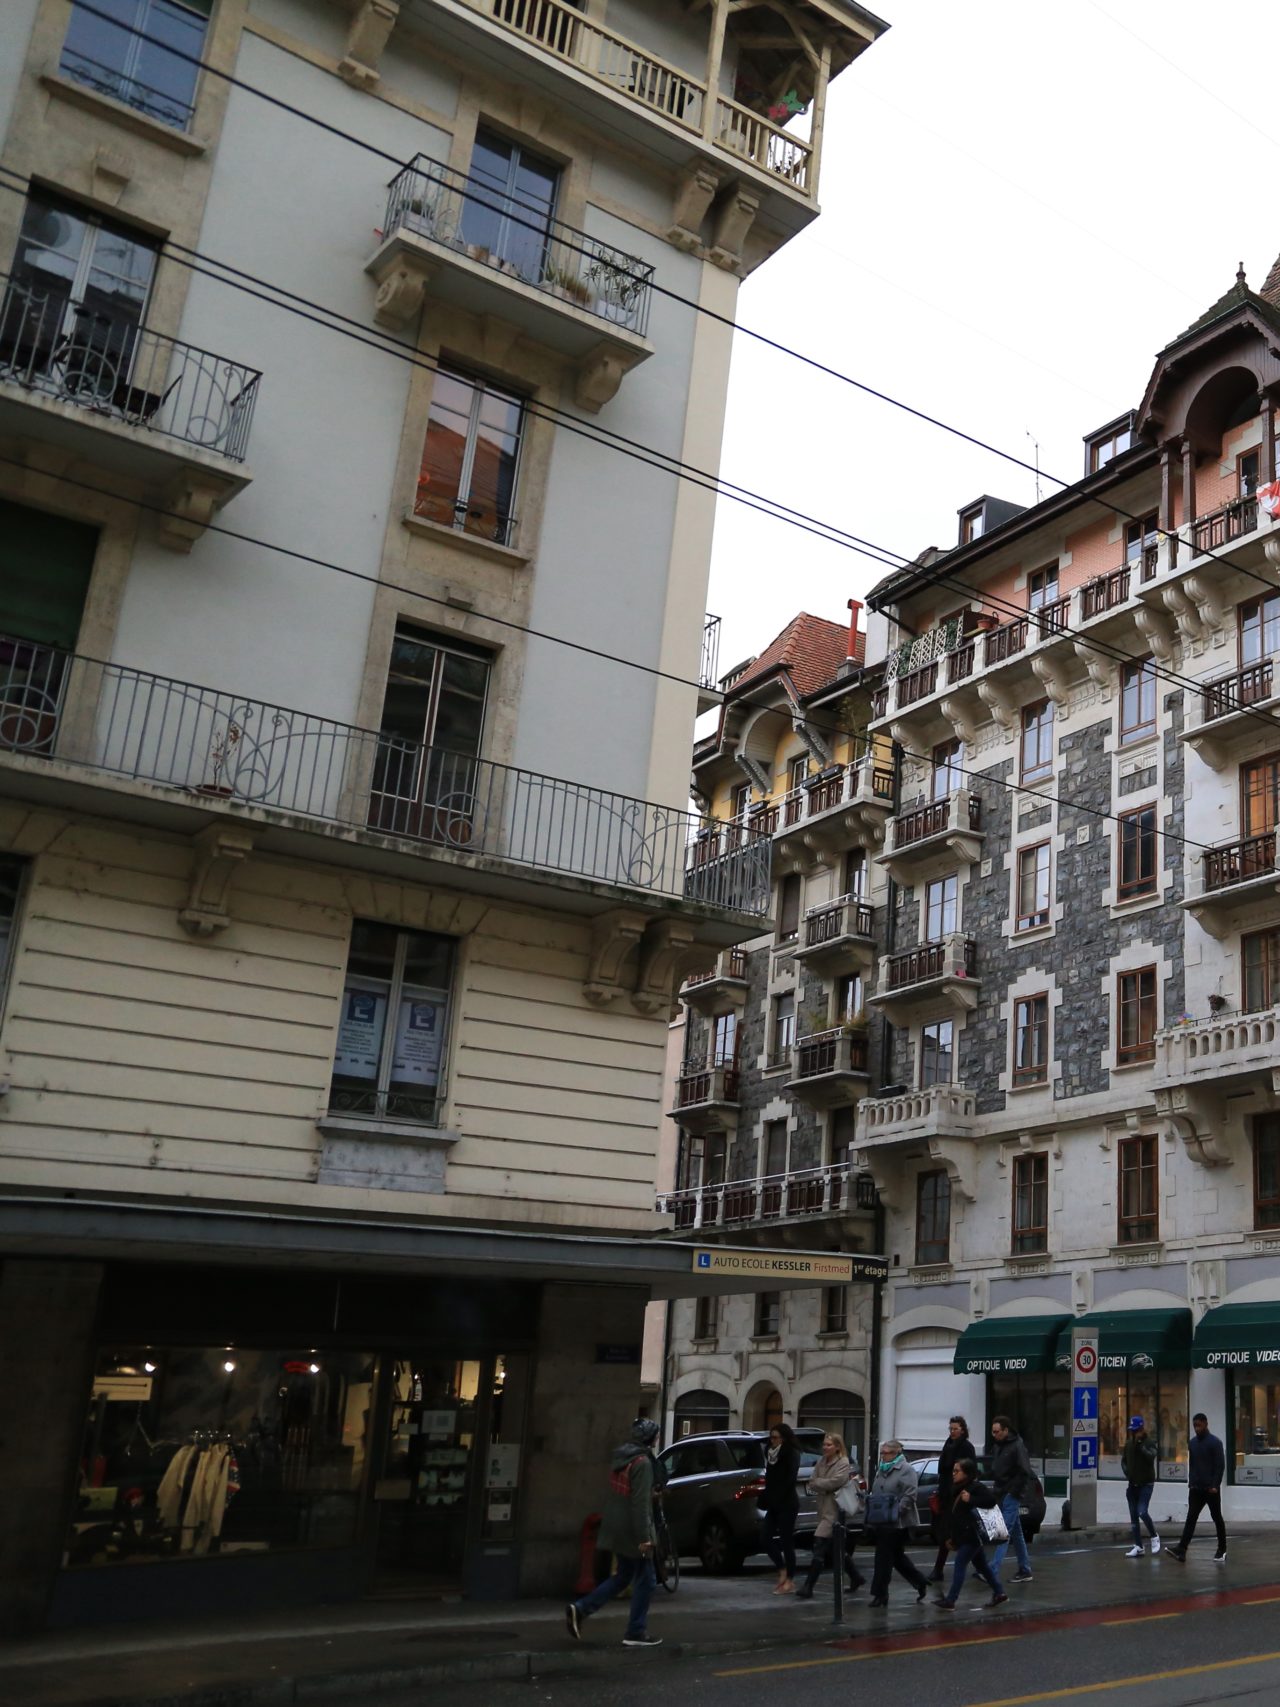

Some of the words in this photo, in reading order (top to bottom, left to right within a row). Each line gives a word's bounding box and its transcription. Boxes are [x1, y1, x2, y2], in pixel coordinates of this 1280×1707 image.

[714, 1257, 740, 1268] AUTO
[741, 1258, 770, 1270] ECOLE
[771, 1261, 811, 1272] KESSLER
[813, 1263, 850, 1274] Firstmed
[864, 1265, 887, 1277] étage
[1081, 1355, 1092, 1366] 30
[1098, 1356, 1127, 1368] TICIEN
[1207, 1351, 1250, 1364] OPTIQUE
[966, 1358, 1000, 1371] OPTIQUE
[1004, 1358, 1027, 1369] VIDEO
[1077, 1440, 1090, 1465] P
